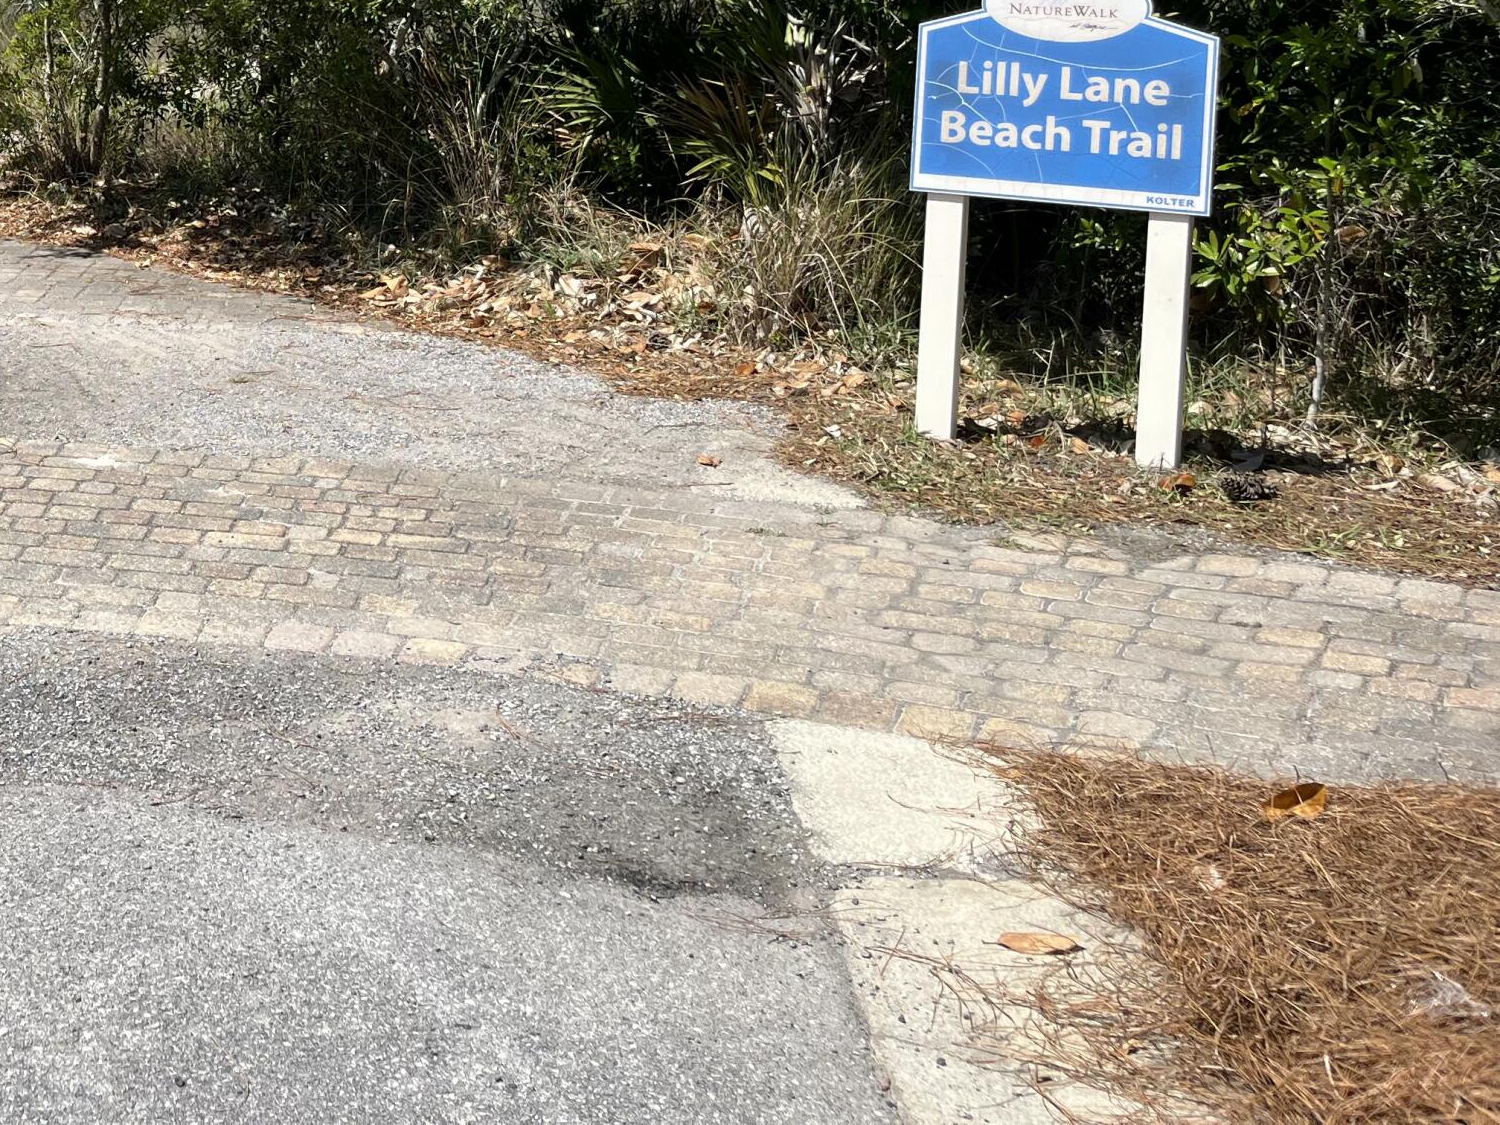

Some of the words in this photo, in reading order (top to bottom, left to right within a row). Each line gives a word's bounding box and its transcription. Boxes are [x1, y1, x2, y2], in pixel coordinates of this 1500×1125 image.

[957, 60, 1049, 108] Lilly
[1059, 66, 1171, 107] Lane
[940, 110, 1071, 152] Beach
[1082, 119, 1184, 160] Trail
[1146, 195, 1195, 208] KOLTER
